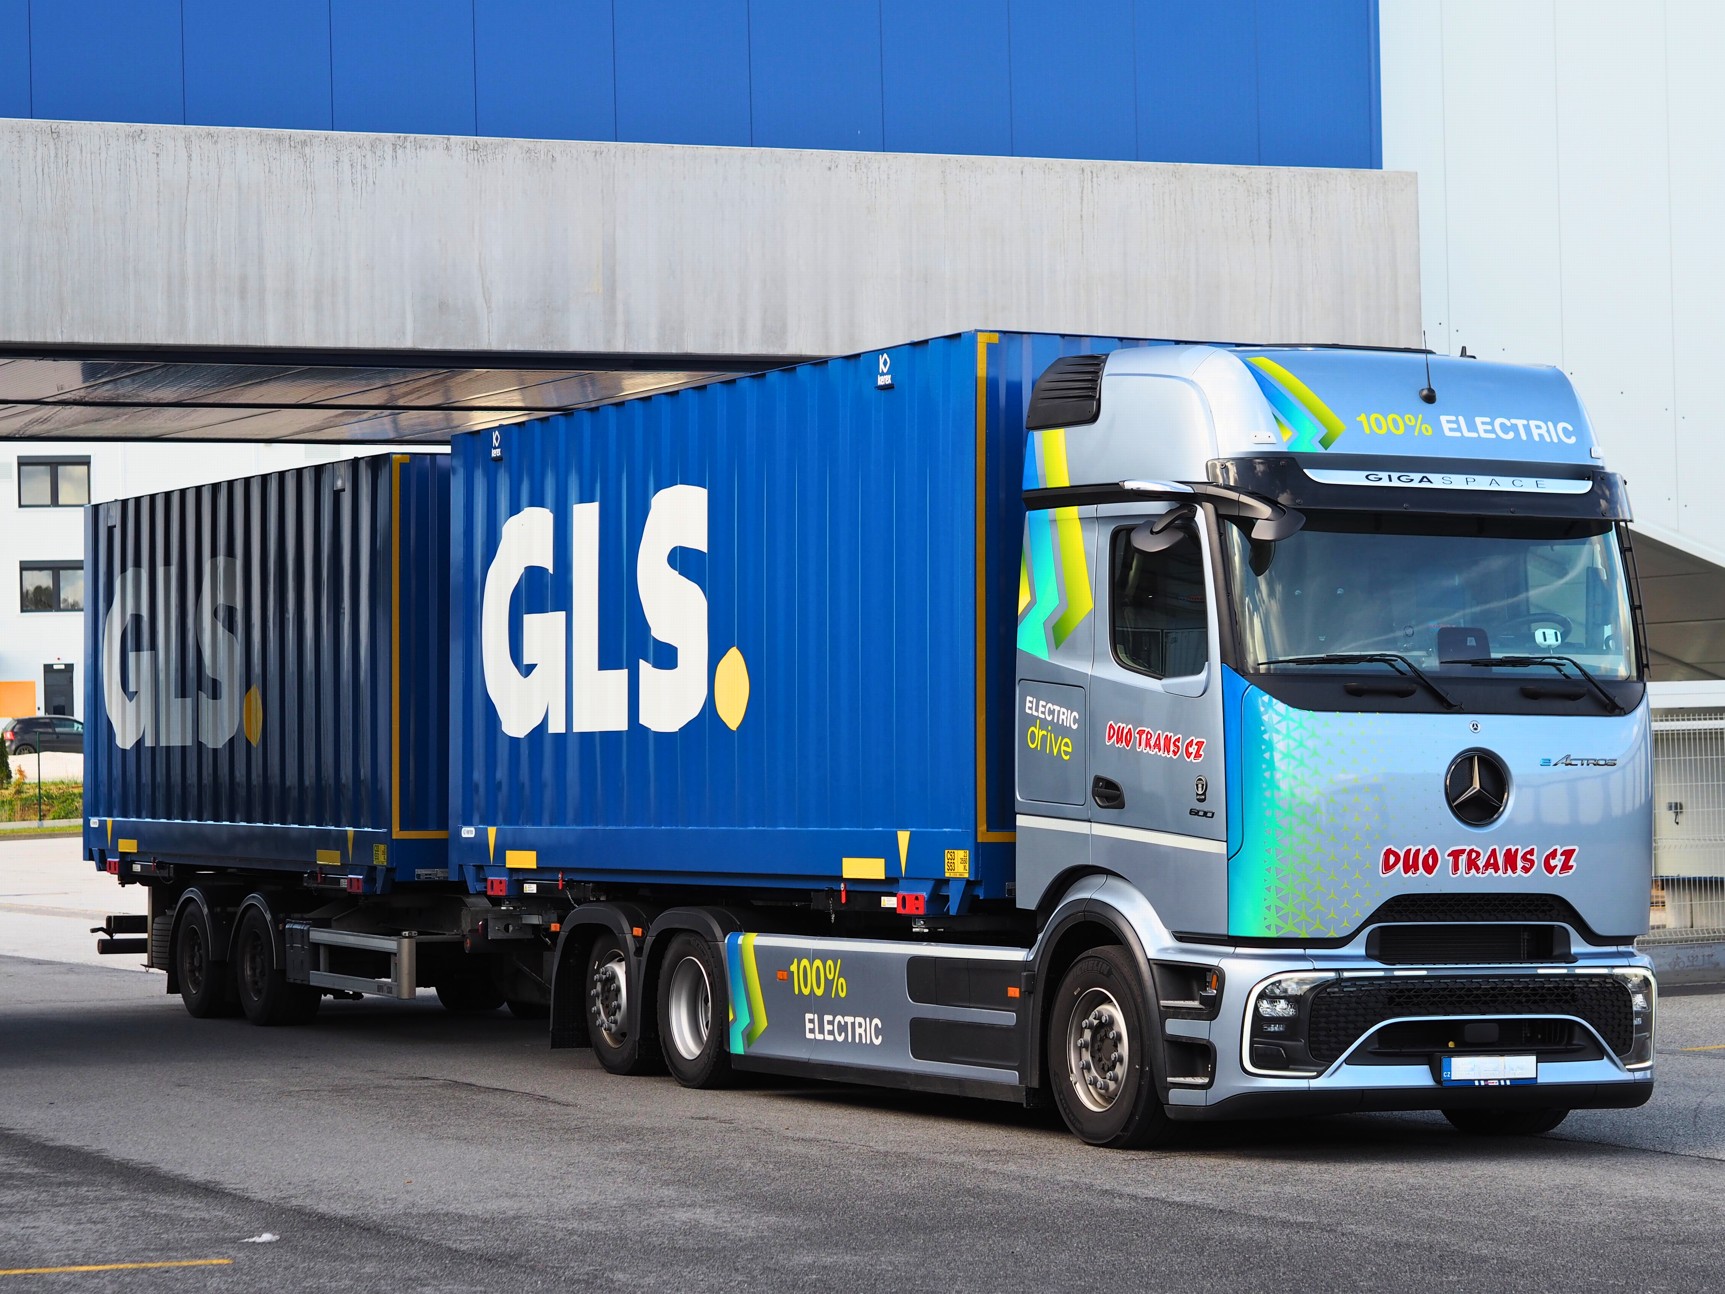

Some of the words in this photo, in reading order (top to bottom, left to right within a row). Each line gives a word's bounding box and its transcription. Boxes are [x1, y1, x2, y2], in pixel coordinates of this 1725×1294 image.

[1356, 413, 1433, 436] 100%
[1439, 415, 1577, 444] ELECTRIC
[1025, 696, 1079, 730] ELECTRIC
[1027, 719, 1073, 761] drive
[1106, 721, 1134, 750] DUO
[1134, 728, 1181, 760] TRANS
[1183, 736, 1207, 763] CZ
[1189, 808, 1215, 818] 600
[1380, 846, 1441, 878] DUO
[1446, 846, 1538, 877] TRANS
[1541, 846, 1579, 877] CZ
[789, 958, 847, 998] 100%
[805, 1013, 883, 1046] ELECTRIC
